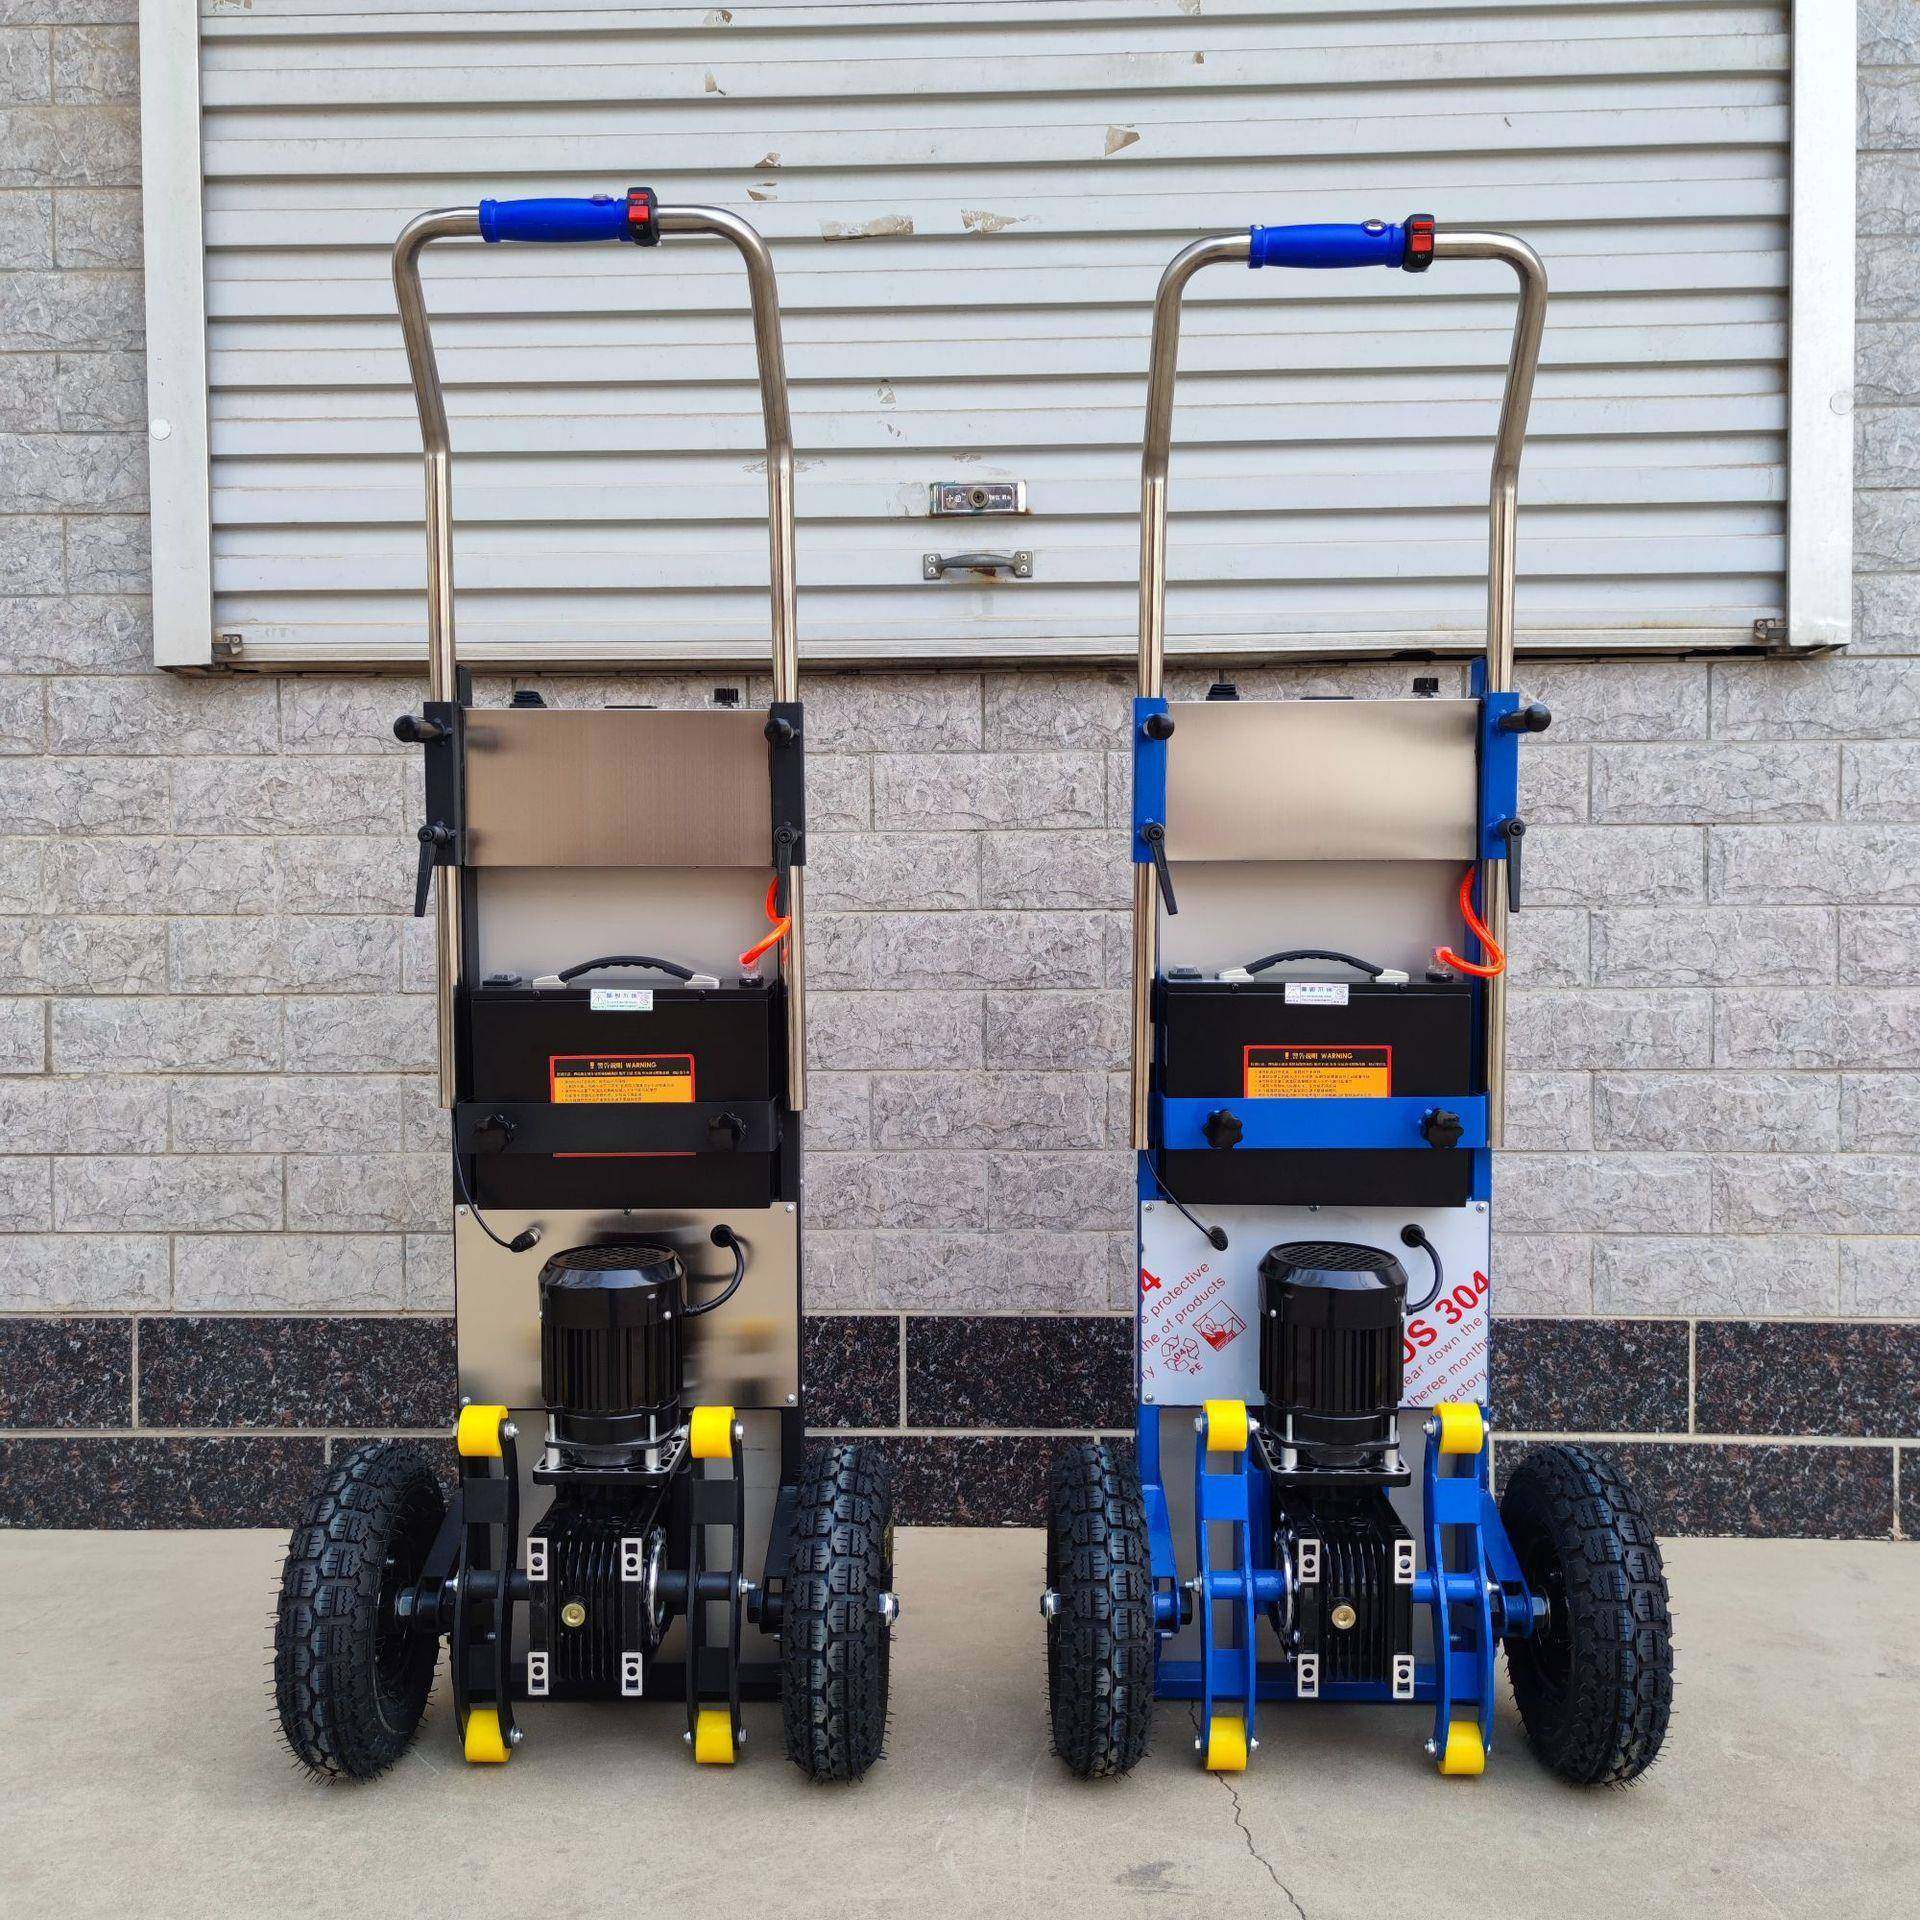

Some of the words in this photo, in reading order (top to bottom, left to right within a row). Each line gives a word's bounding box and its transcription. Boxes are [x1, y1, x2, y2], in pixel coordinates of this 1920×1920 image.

[625, 1061, 657, 1069] WARNING
[1320, 1052, 1353, 1060] WARNING
[1150, 1263, 1210, 1317] protective
[1161, 1318, 1175, 1333] of
[1174, 1276, 1226, 1324] products
[1435, 1270, 1489, 1325] 304
[1189, 1362, 1204, 1376] PE
[1403, 1364, 1425, 1388] ear
[1427, 1336, 1461, 1366] down
[1460, 1317, 1483, 1337] the
[1407, 1374, 1448, 1407] theree
